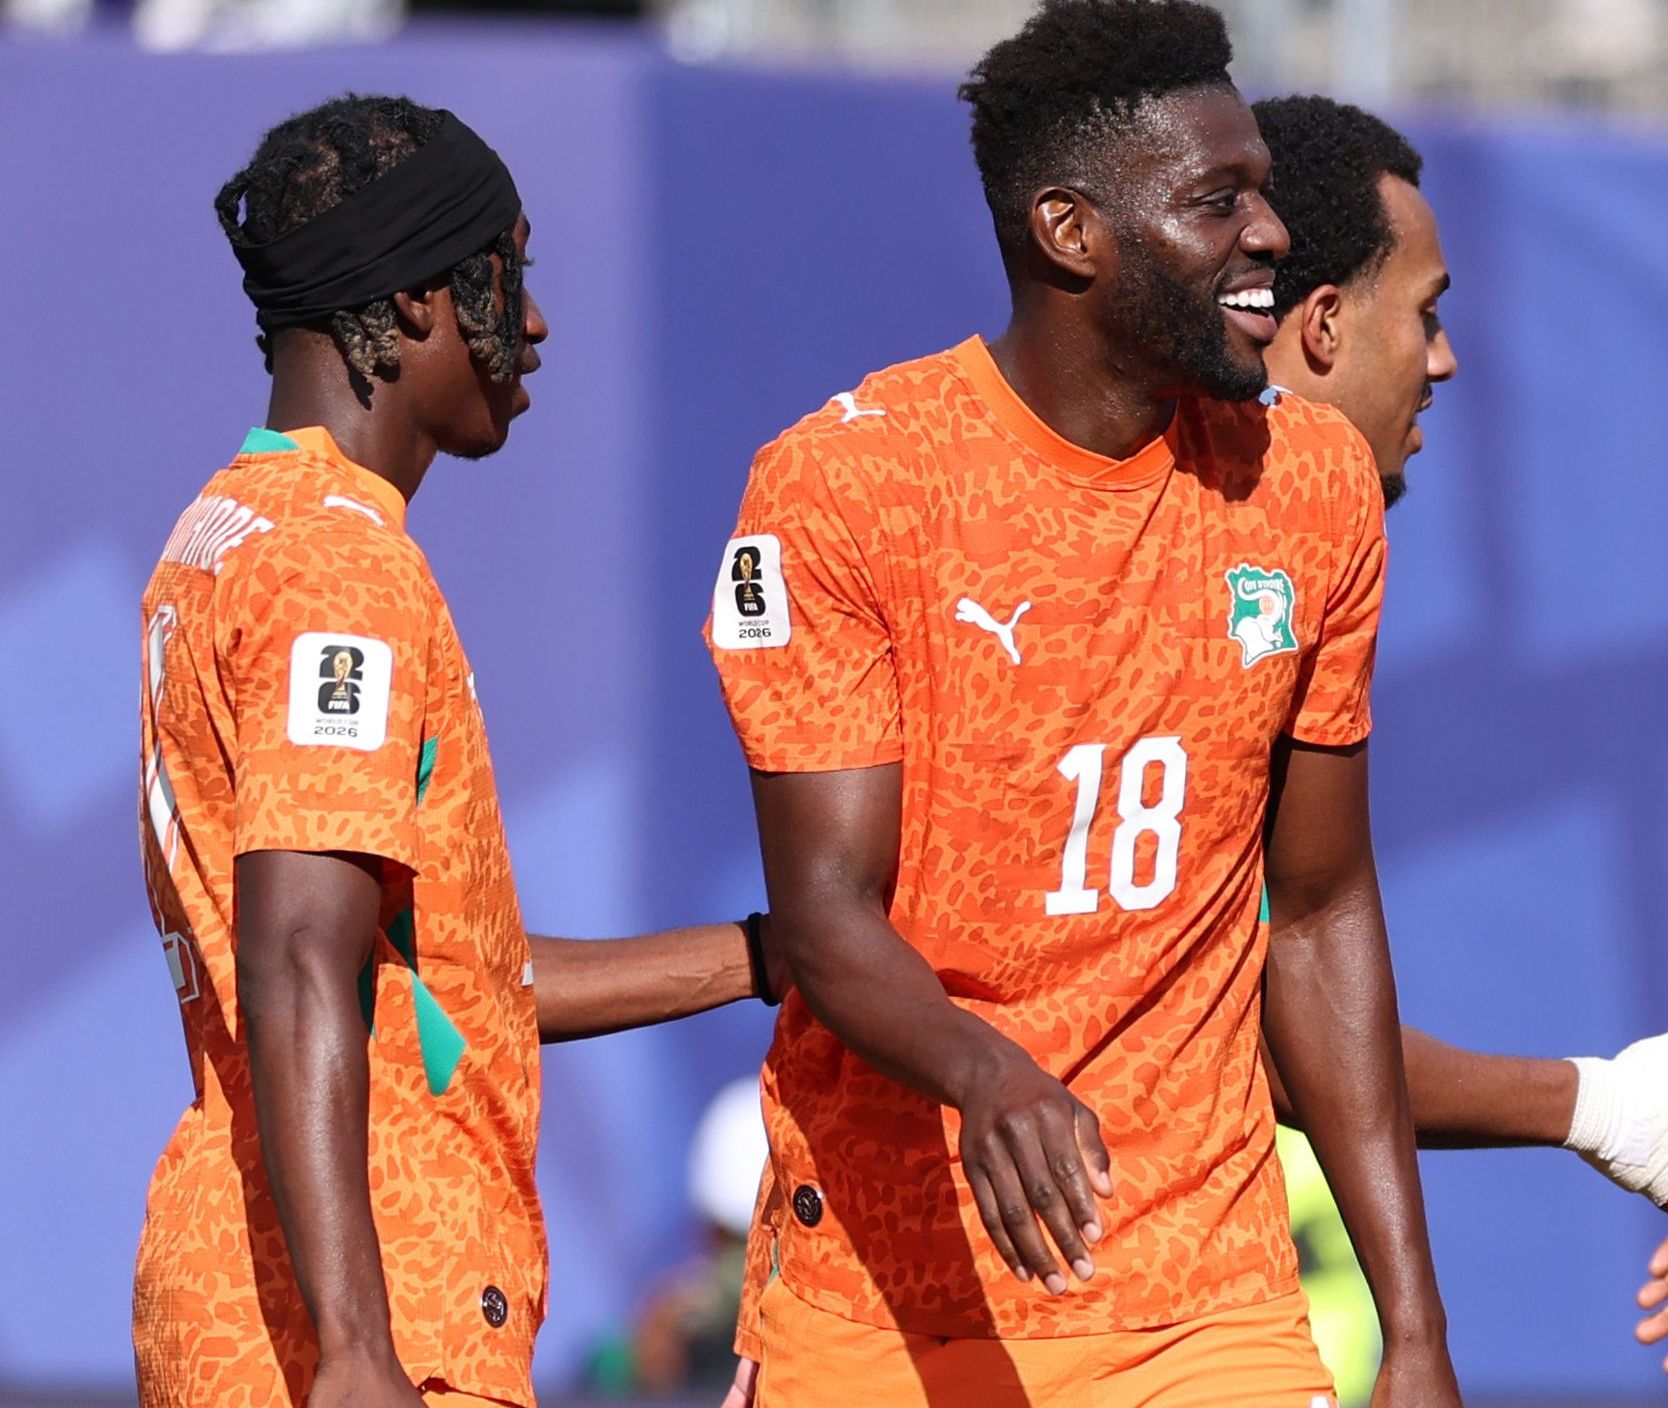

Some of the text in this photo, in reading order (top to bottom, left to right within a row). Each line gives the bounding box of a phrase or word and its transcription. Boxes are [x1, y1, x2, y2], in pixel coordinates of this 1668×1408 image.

[738, 627, 772, 639] 2026
[313, 726, 359, 738] 2026
[1045, 736, 1188, 916] 18
